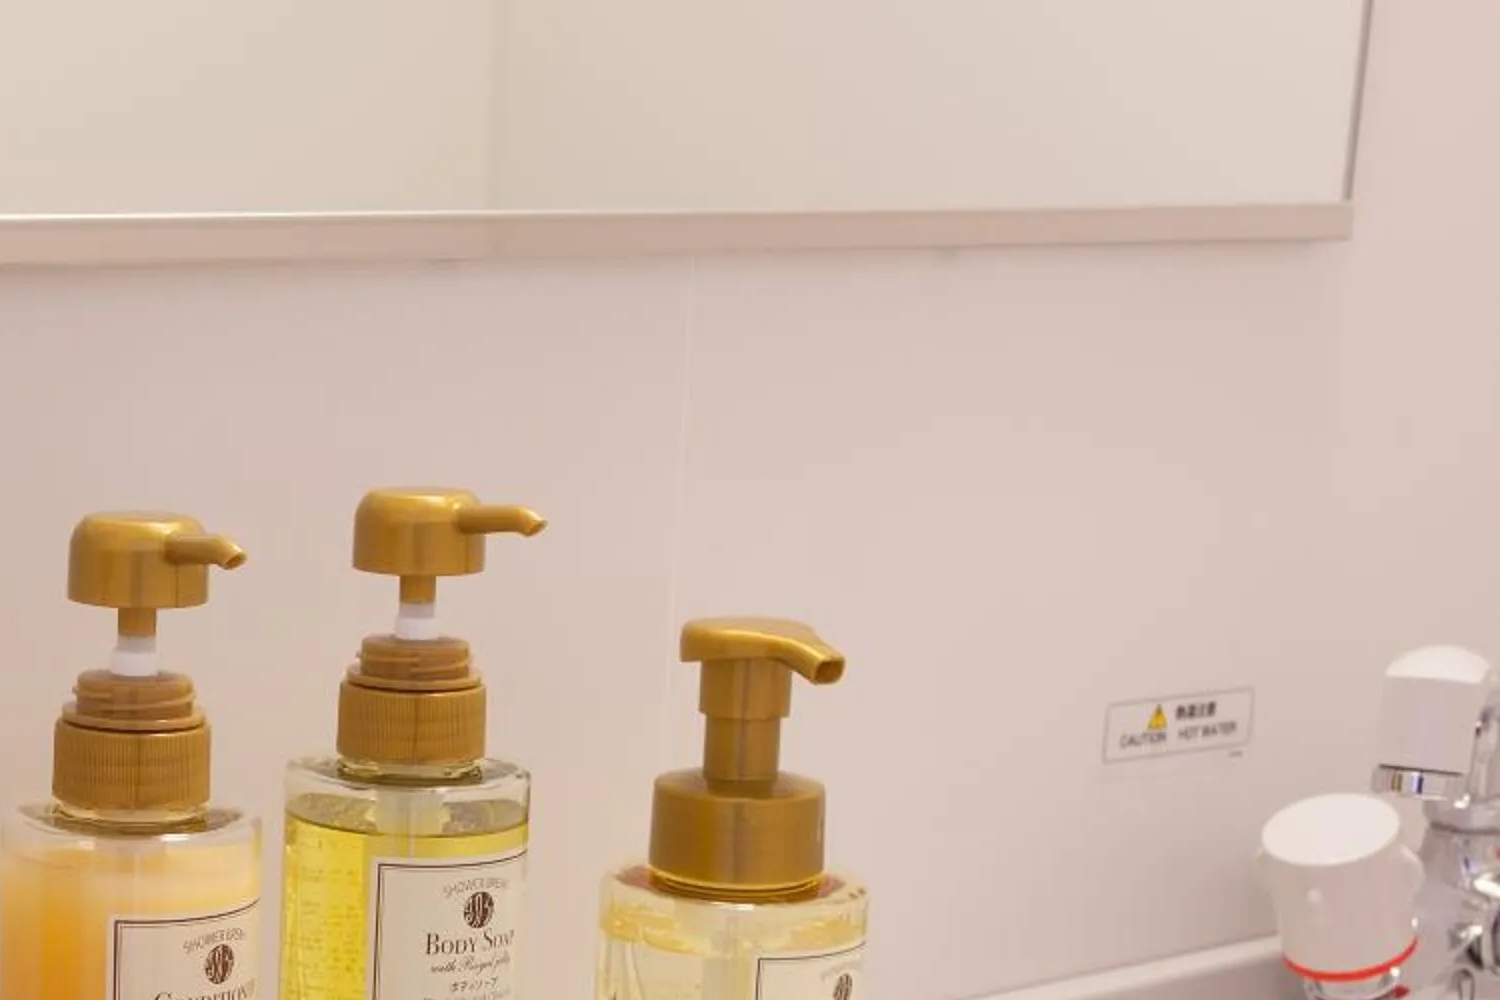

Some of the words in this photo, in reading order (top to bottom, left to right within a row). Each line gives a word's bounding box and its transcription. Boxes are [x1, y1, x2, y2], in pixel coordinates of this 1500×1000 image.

[1119, 730, 1167, 749] CAUTION
[1178, 725, 1200, 741] HOT
[1201, 720, 1237, 739] WATER
[425, 931, 476, 956] BODY
